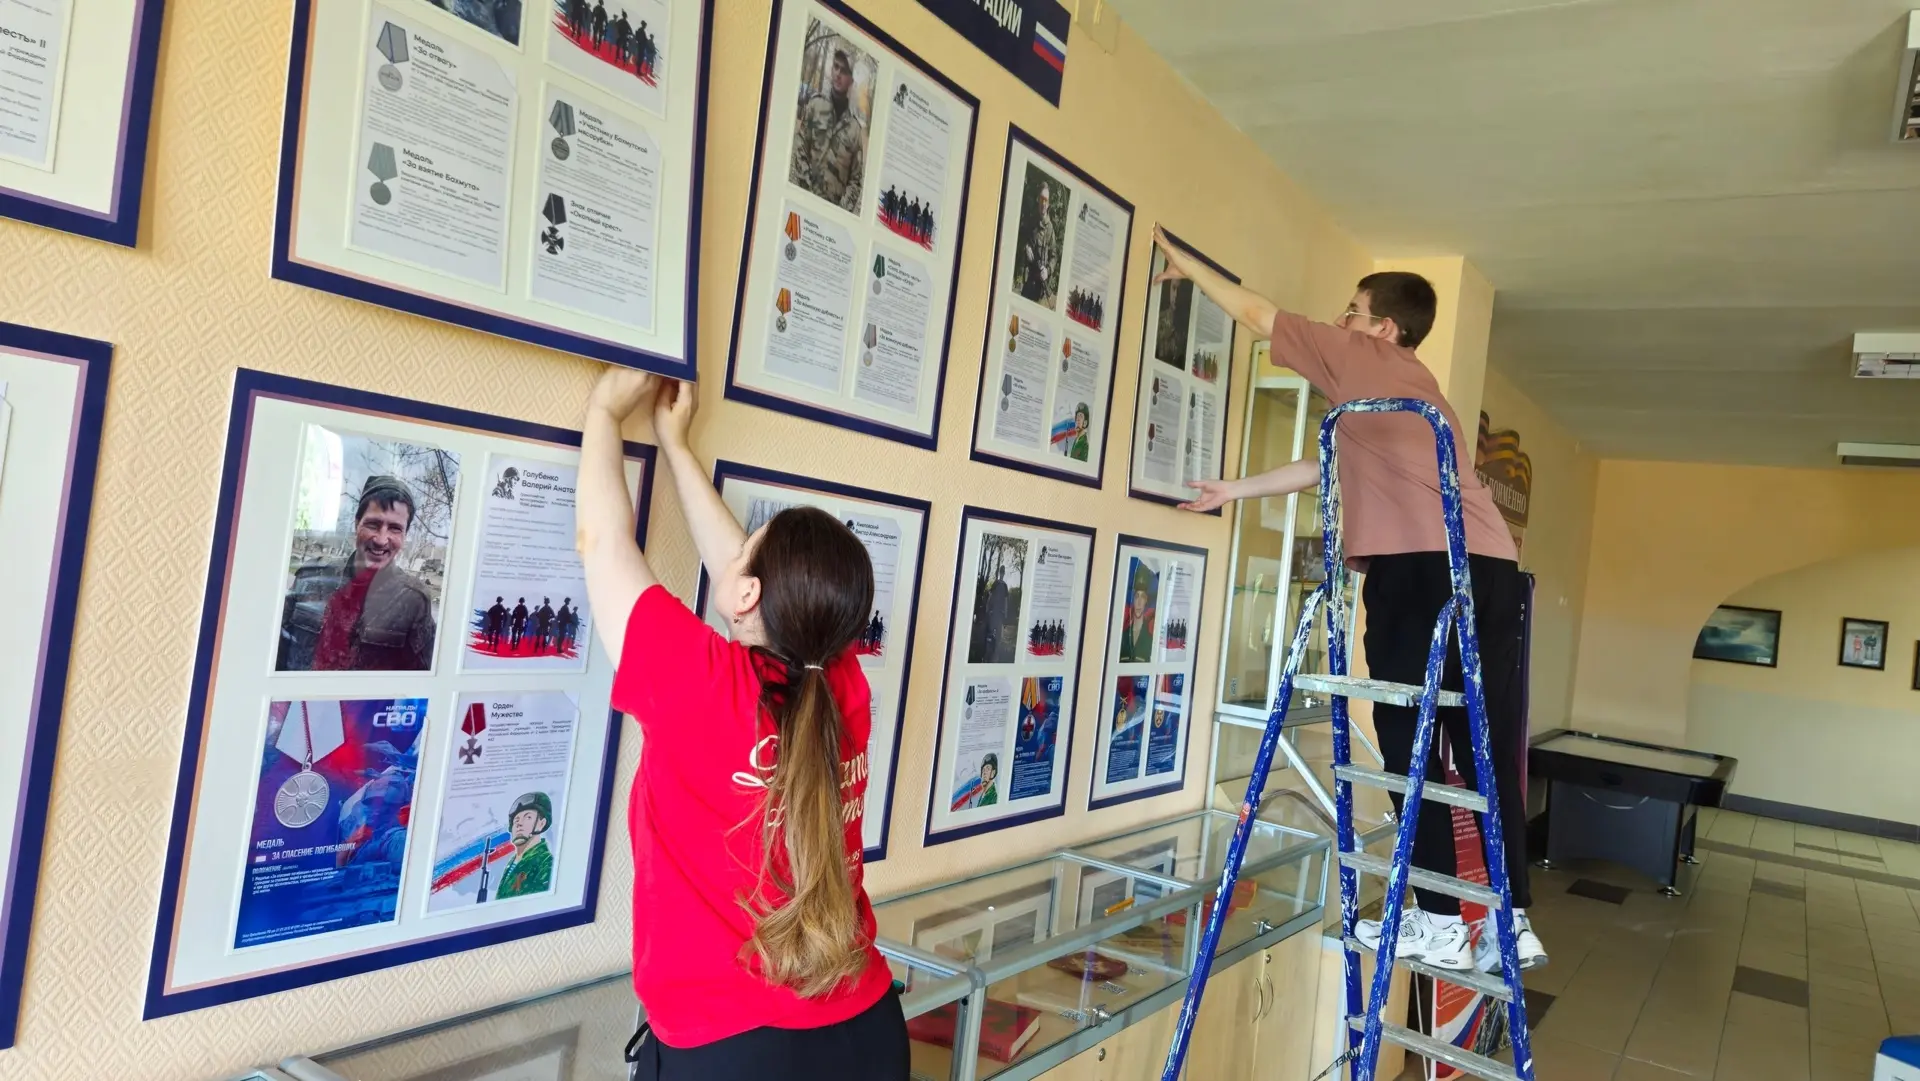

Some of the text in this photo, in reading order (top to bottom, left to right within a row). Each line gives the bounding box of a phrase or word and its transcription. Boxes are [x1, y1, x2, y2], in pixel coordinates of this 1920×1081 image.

[973, 0, 1022, 38] АЦИИ
[414, 34, 444, 53] Медаль
[429, 52, 457, 69] отвагу»
[403, 148, 434, 165] Медаль
[402, 159, 480, 191] «За взятие Бахмута»
[523, 470, 559, 481] Голубенко
[522, 480, 551, 491] Валерий
[385, 704, 418, 712] НАГРАДЫ
[492, 702, 514, 710] Орден
[373, 712, 416, 727] СВО
[256, 838, 285, 849] МЕДАЛЬ
[271, 842, 357, 860] ЗА СПАСЕНИЕ ПОГИБАВШИХ
